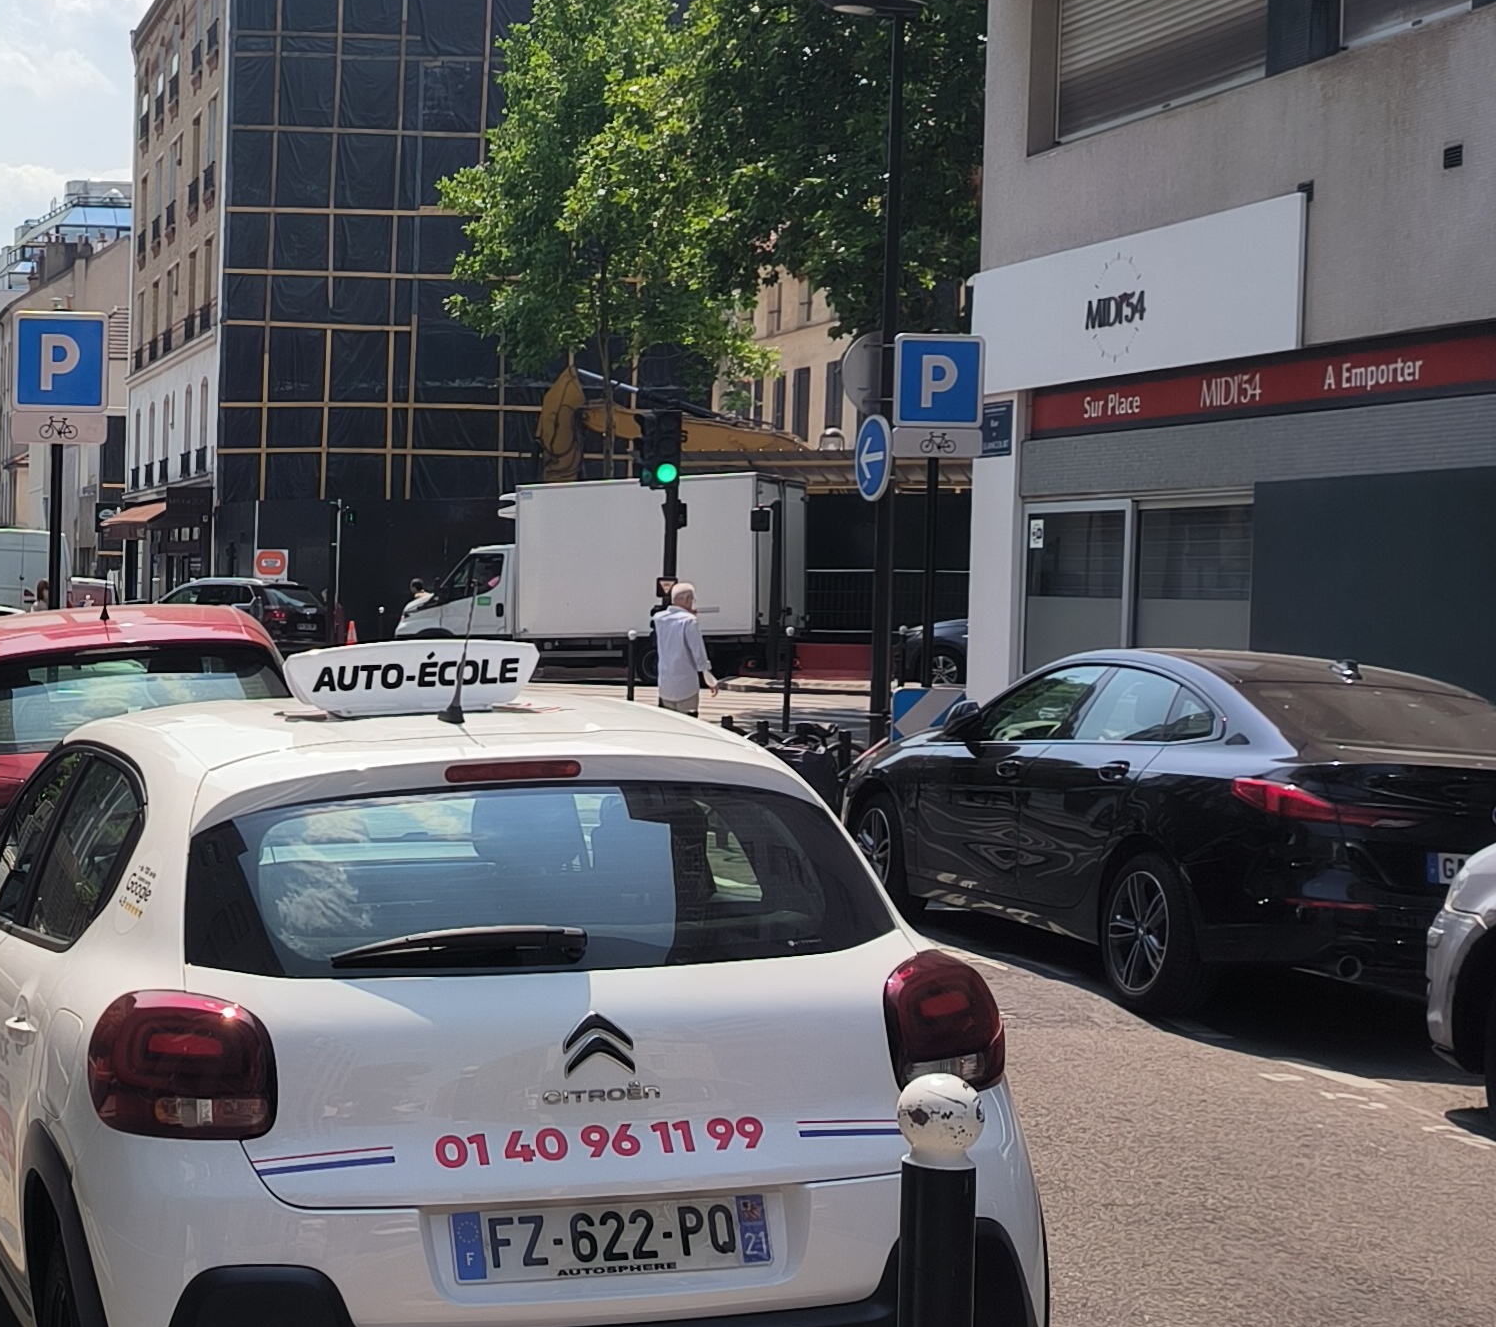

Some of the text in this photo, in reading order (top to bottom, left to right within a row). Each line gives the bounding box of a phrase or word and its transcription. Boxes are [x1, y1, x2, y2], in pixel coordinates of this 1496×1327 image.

[40, 333, 81, 391] P
[920, 353, 959, 409] P
[1323, 357, 1423, 391] A Emporter
[1083, 392, 1141, 419] Sur Place
[312, 651, 520, 693] AUTO-ÉCOLE
[126, 872, 152, 904] Google
[542, 1080, 662, 1105] CITROËN
[435, 1116, 764, 1169] 01 40 96 11 99
[487, 1203, 736, 1269] FZ-622-PQ
[744, 1233, 768, 1255] 21
[557, 1261, 678, 1277] AUTOSPHERE
